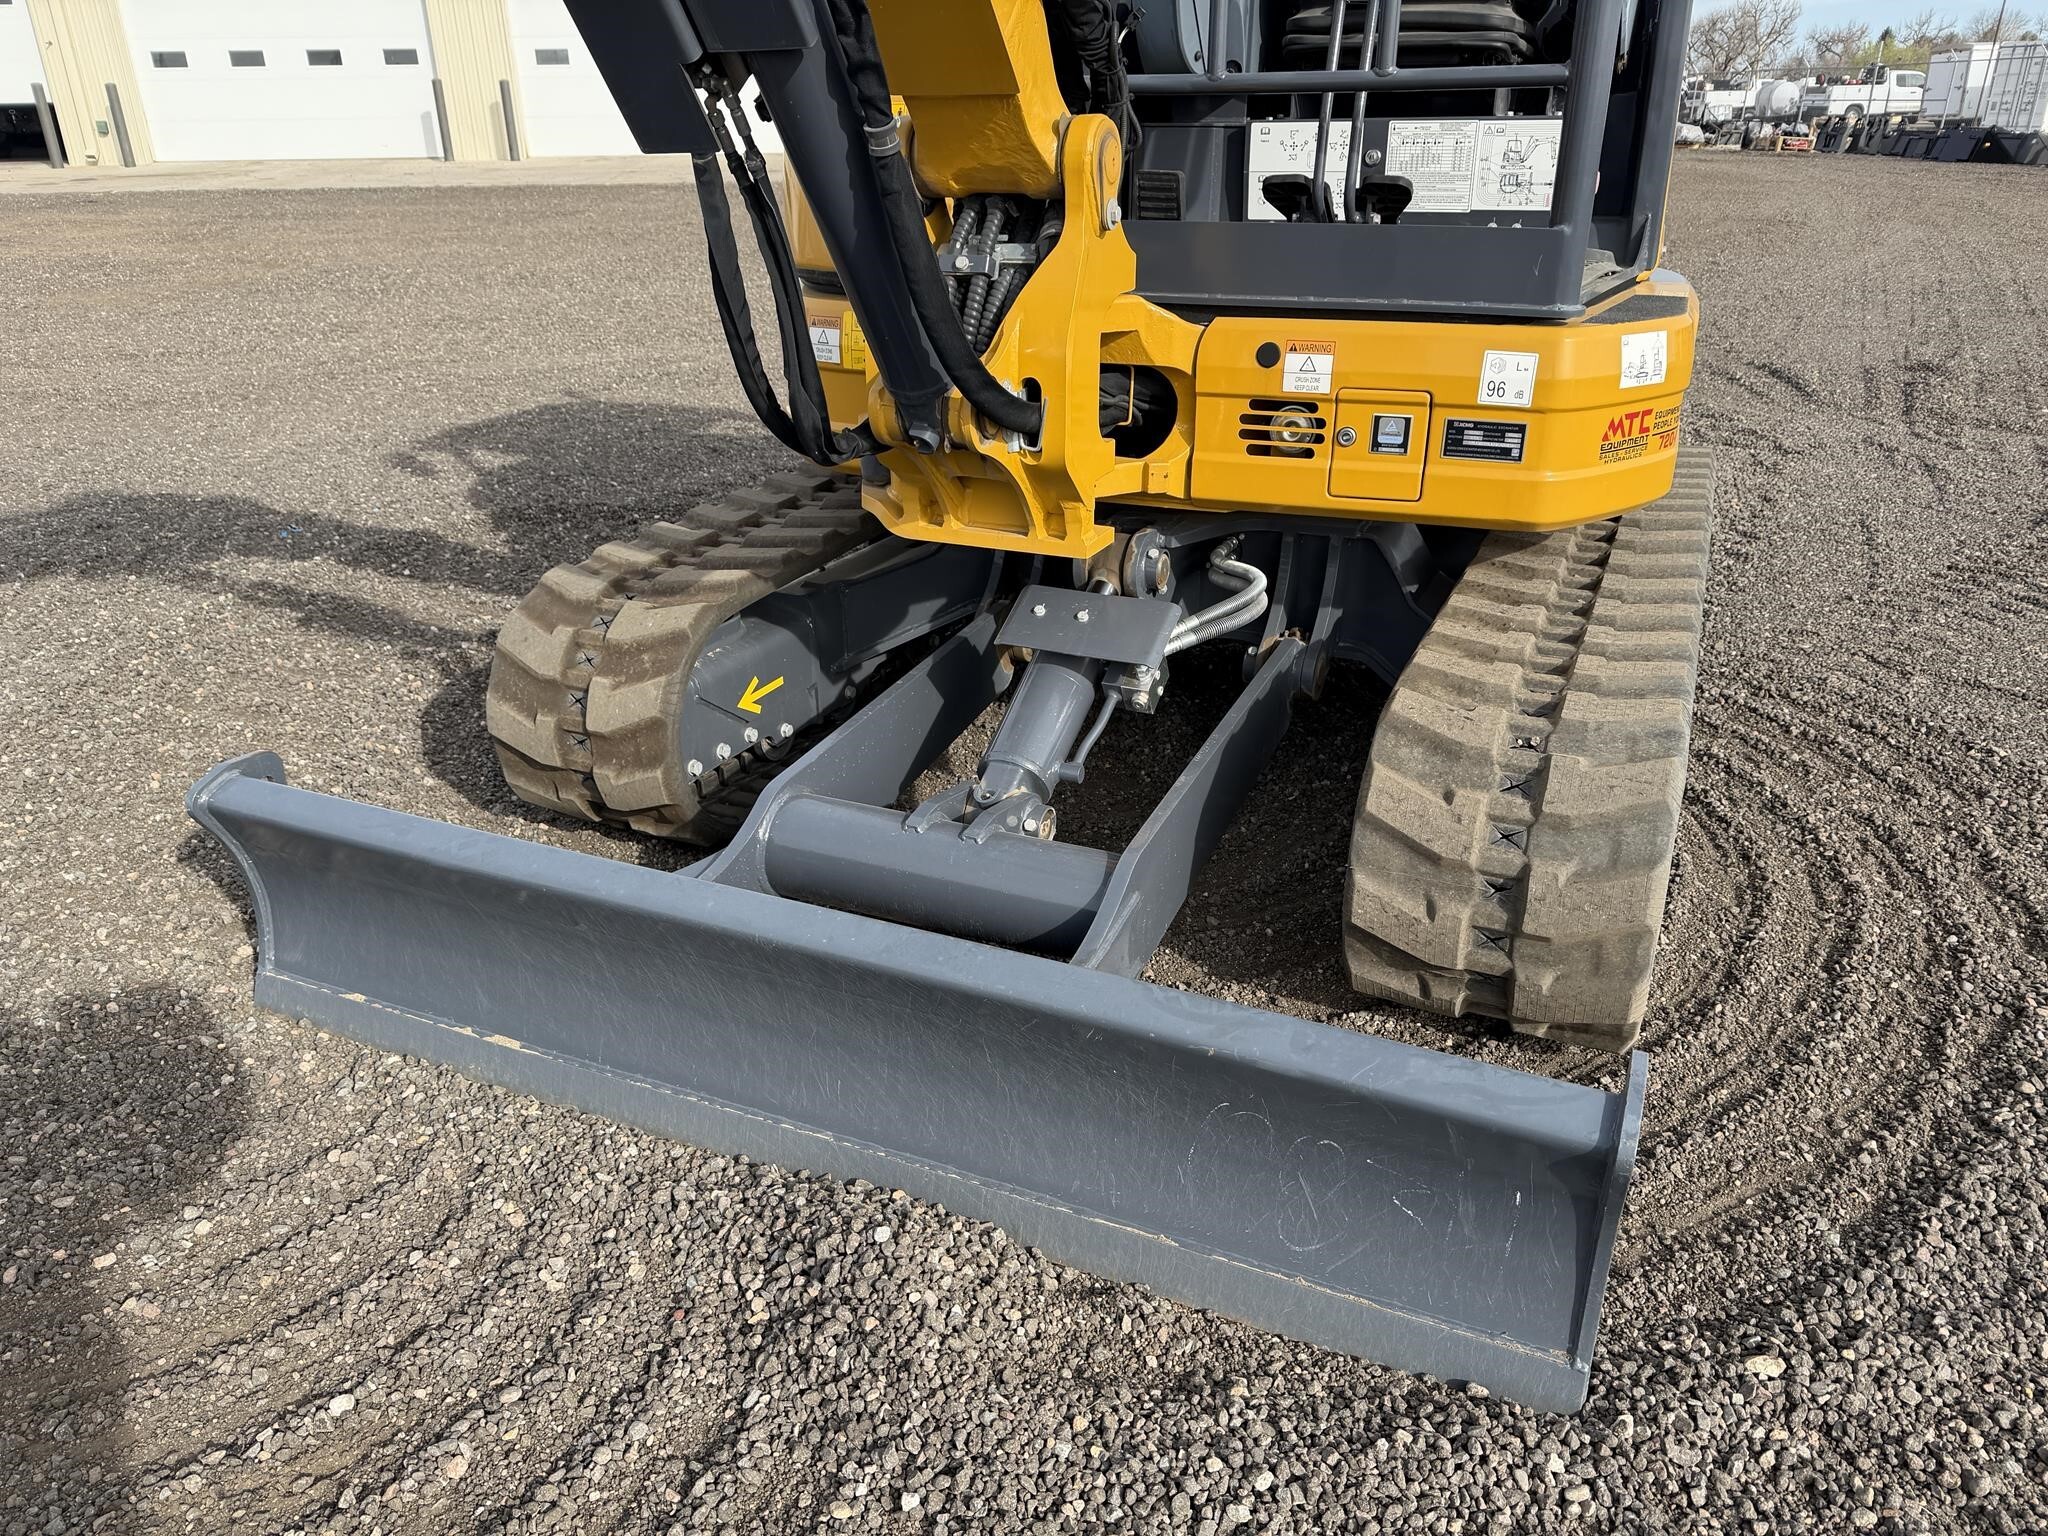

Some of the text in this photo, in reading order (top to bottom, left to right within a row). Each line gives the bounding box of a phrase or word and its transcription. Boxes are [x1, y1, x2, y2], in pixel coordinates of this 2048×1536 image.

[817, 319, 838, 328] WARNING
[1298, 343, 1332, 353] WARNING
[1486, 380, 1524, 400] 96 dB
[1601, 408, 1654, 442] MTC
[1652, 417, 1673, 431] PEOPLE
[1600, 434, 1650, 451] EQUIPMENT
[1598, 451, 1619, 461] SALES
[1624, 445, 1648, 456] SERVICE
[1603, 452, 1643, 464] HYDRAULICS
